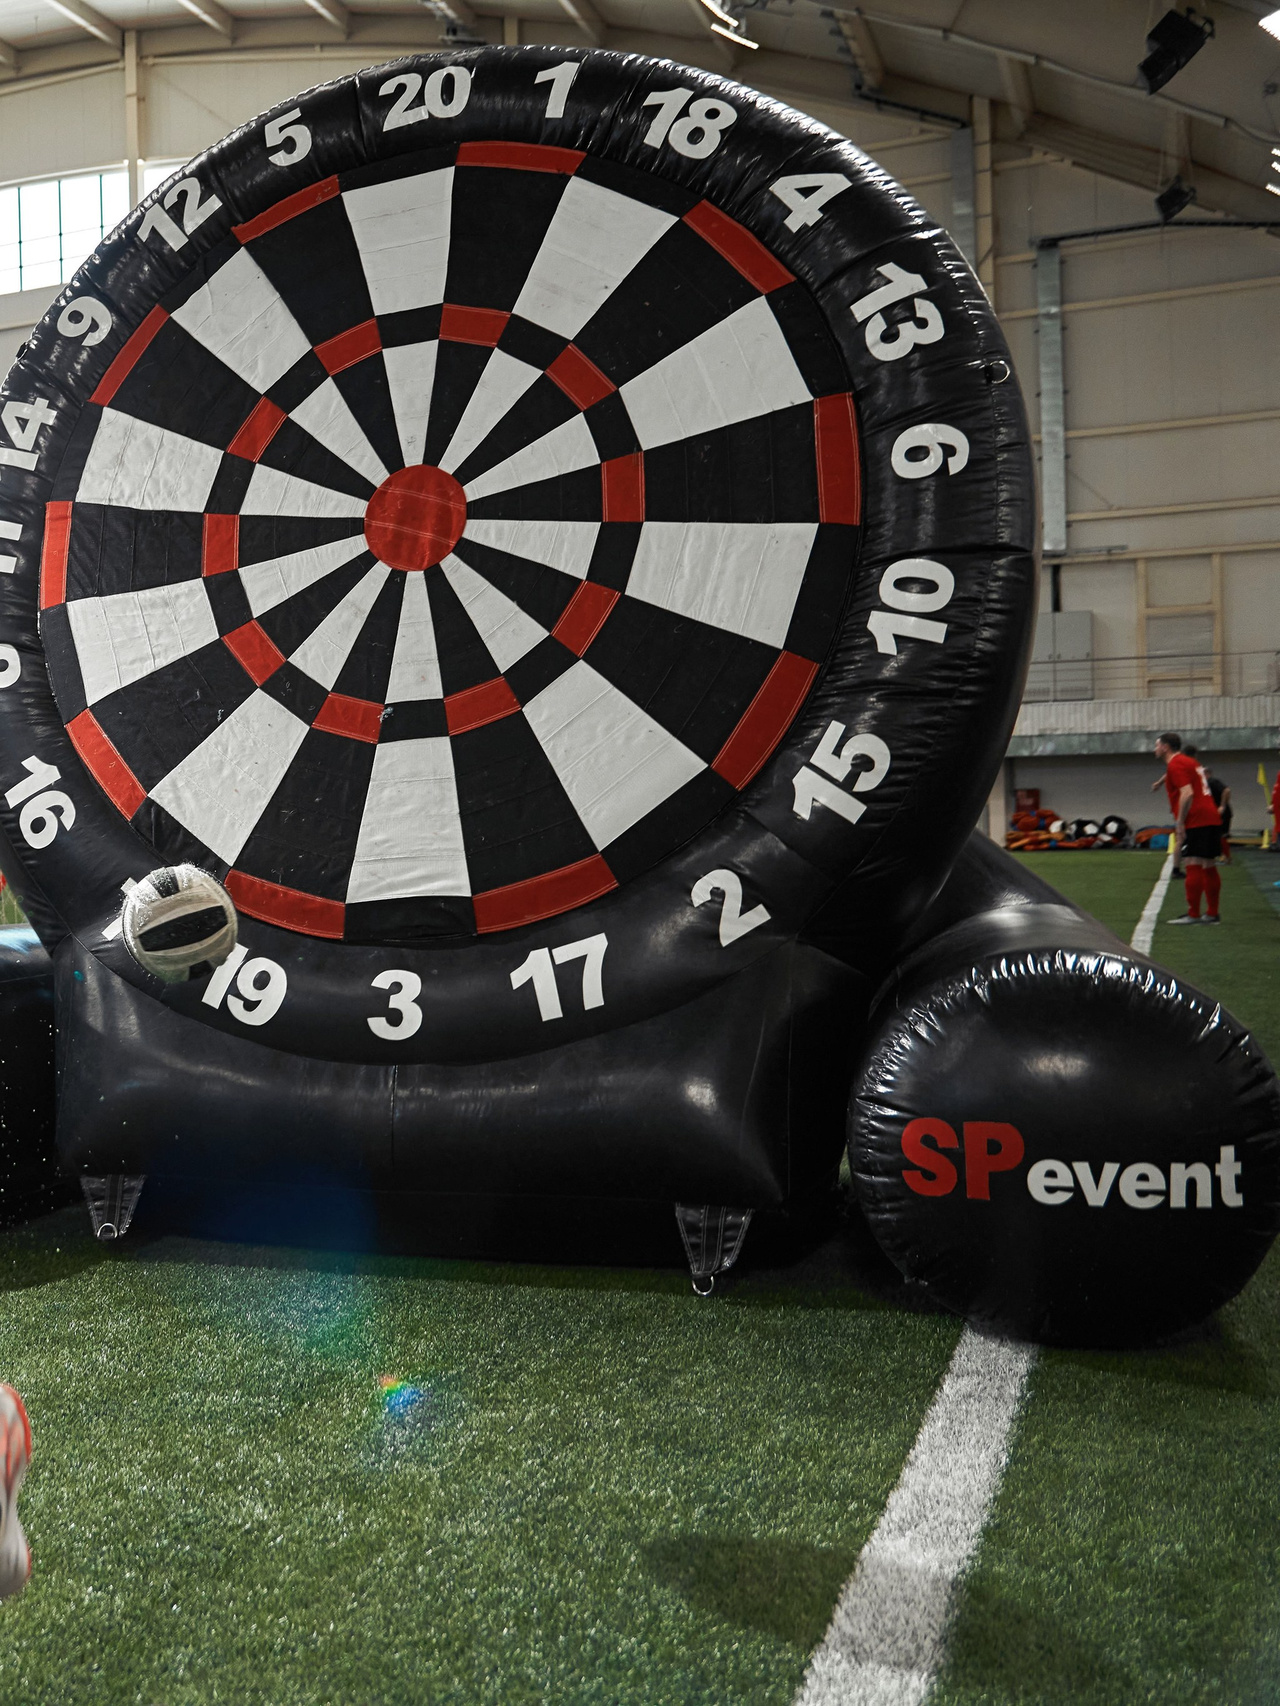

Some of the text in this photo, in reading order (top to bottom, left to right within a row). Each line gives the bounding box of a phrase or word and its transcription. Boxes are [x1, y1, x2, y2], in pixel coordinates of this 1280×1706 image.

[377, 65, 472, 132] 20
[534, 61, 581, 119] 1
[641, 87, 738, 160] 18
[263, 107, 313, 168] 5
[136, 176, 223, 252] 12
[768, 172, 853, 233] 4
[56, 295, 113, 348] 9
[849, 261, 946, 362] 13
[890, 422, 970, 480] 6
[865, 557, 956, 657] 10
[3, 755, 77, 850] 16
[791, 719, 892, 826] 15
[690, 868, 772, 948] 2
[201, 942, 288, 1027] 19
[366, 968, 423, 1042] 3
[509, 932, 610, 1023] 17
